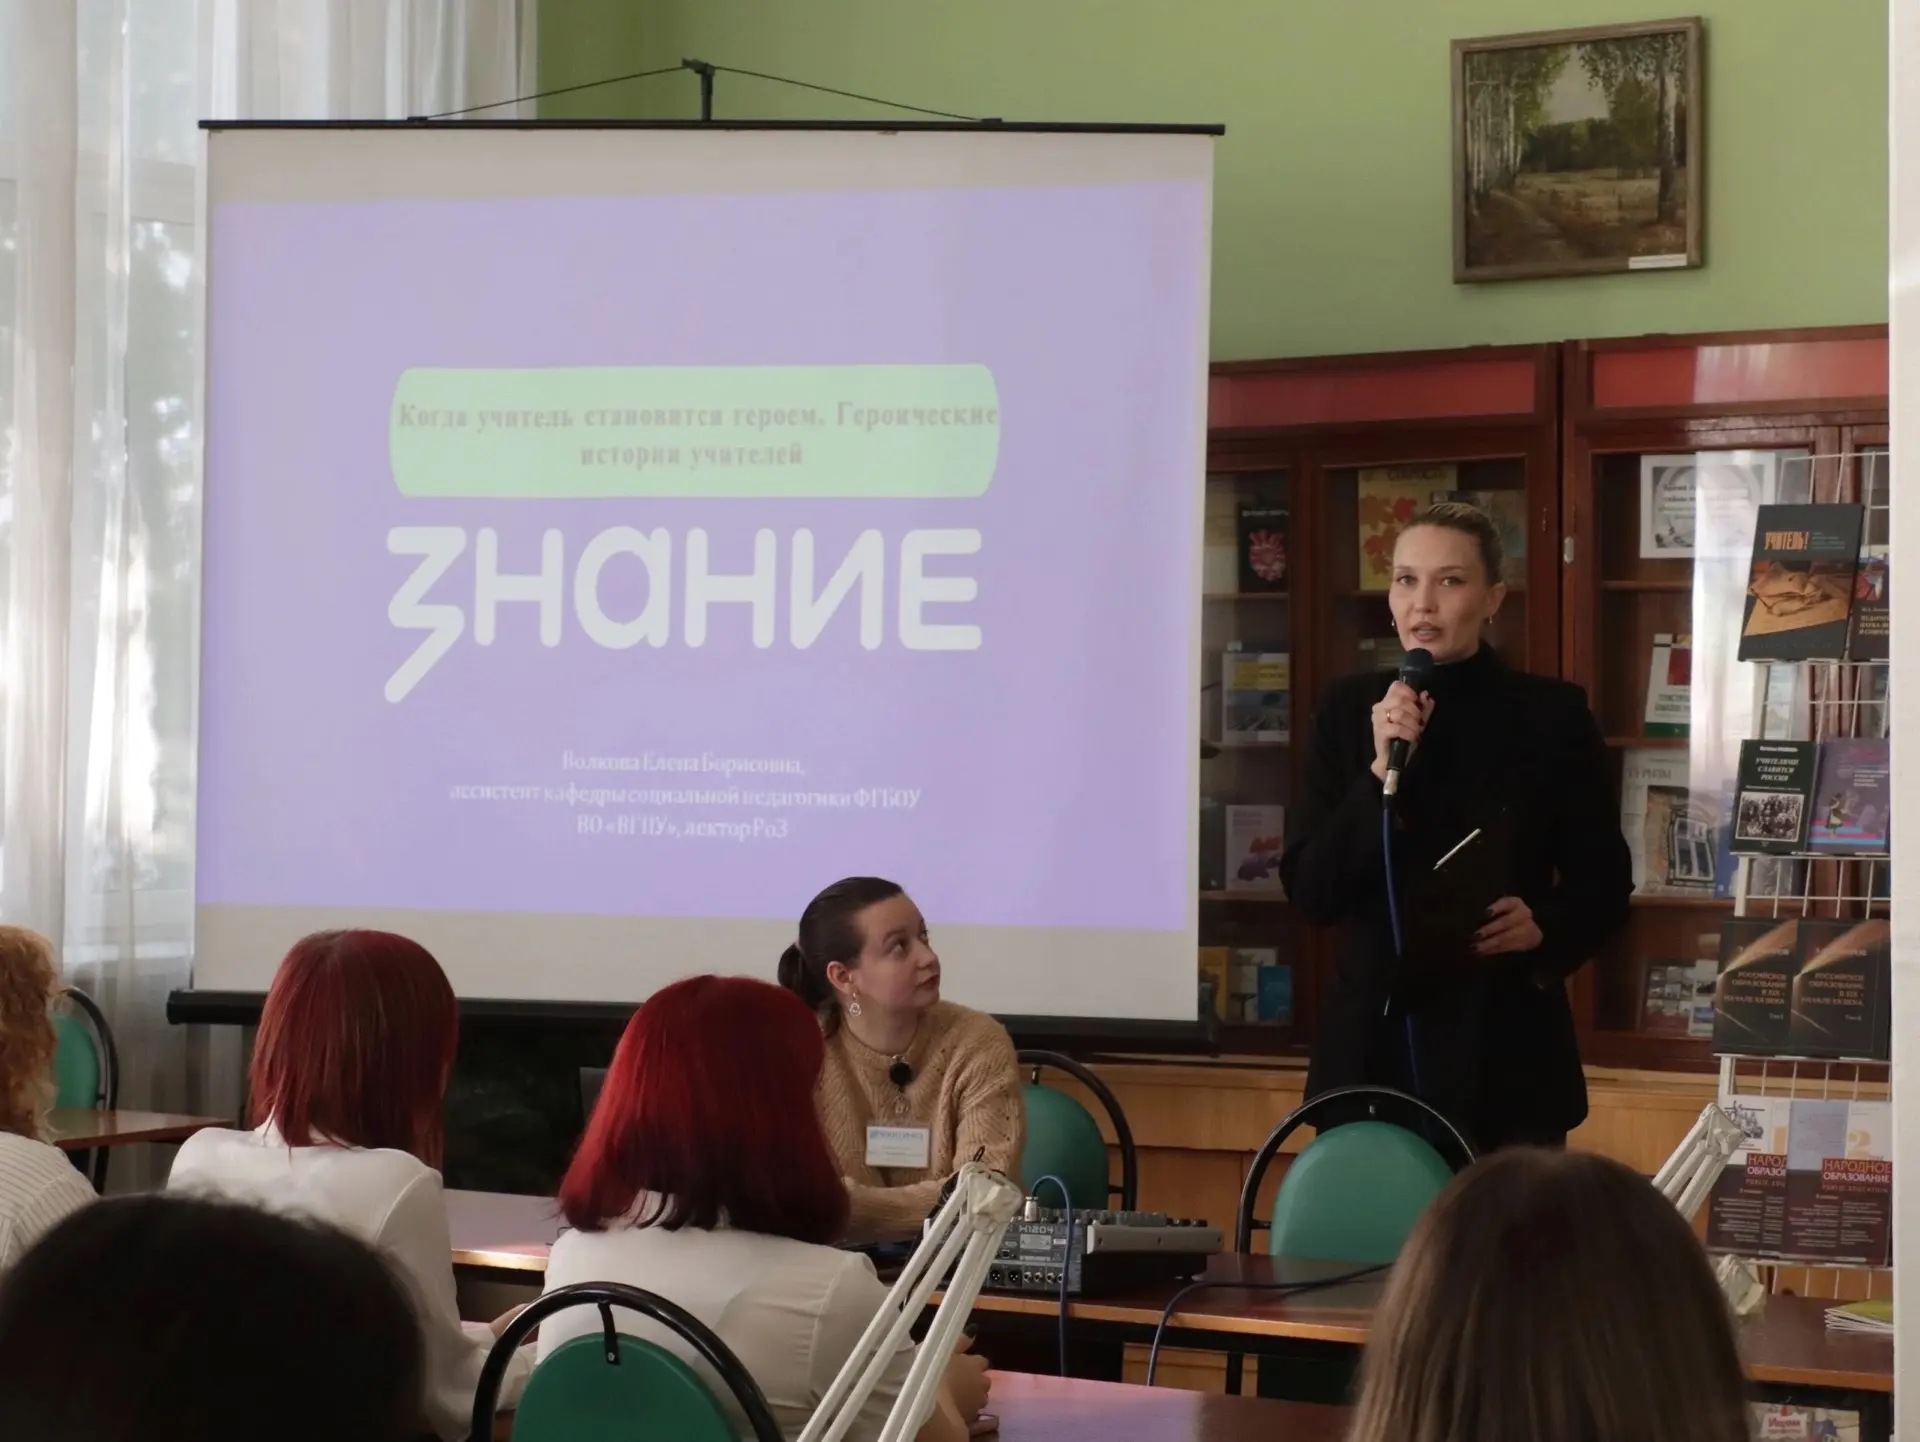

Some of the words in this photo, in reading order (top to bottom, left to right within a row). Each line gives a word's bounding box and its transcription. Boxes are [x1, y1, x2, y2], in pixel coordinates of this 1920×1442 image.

[397, 402, 468, 428] Когда
[477, 408, 574, 434] учитель
[584, 407, 722, 427] становится
[734, 407, 825, 432] героем.
[837, 401, 998, 432] Героические
[581, 445, 680, 471] истории
[690, 441, 802, 471] учителей
[562, 749, 639, 770] Волкова
[643, 751, 698, 771] Елена
[702, 752, 805, 777] Борисовна,
[449, 784, 541, 801] ассистент
[544, 780, 625, 806] кафедры
[628, 785, 739, 805] социальной
[743, 791, 850, 808] педагогики
[577, 813, 603, 834] ВО
[684, 821, 750, 842] лектор
[1823, 1171, 1890, 1183] ОБРАЗОВАНИЕ
[1824, 1160, 1891, 1174] НАРОДНОЕ
